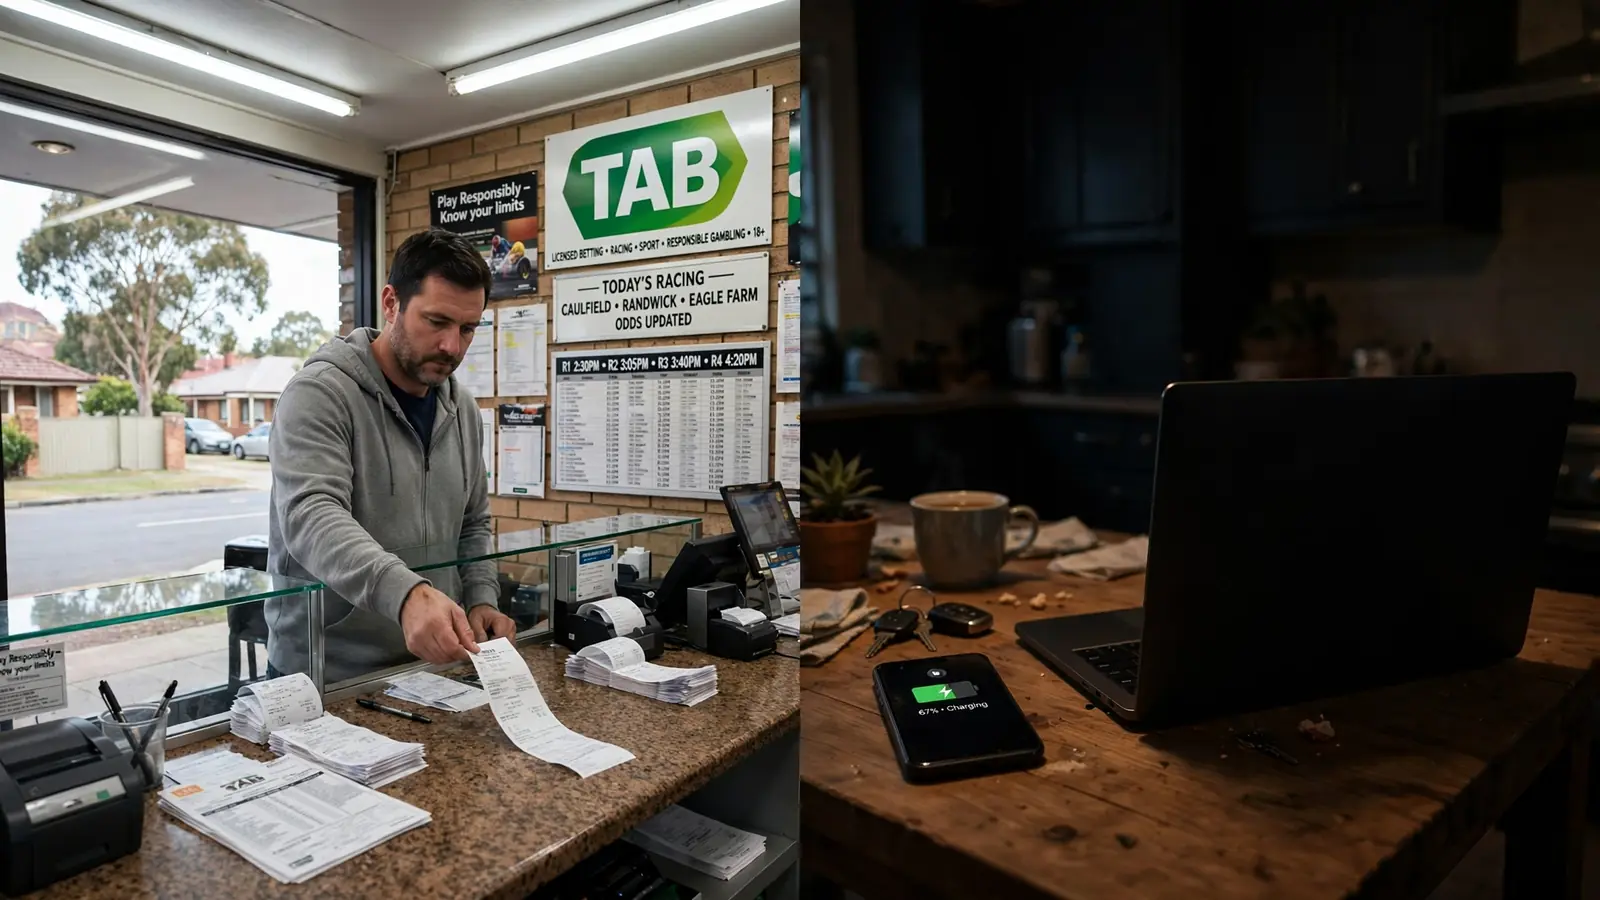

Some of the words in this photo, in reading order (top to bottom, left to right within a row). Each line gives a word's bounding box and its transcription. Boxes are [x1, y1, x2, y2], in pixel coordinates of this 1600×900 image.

[580, 136, 720, 221] TAB
[437, 194, 458, 209] Play
[460, 181, 522, 206] Responsibly
[440, 209, 468, 224] Know
[470, 205, 493, 222] your
[495, 199, 525, 215] limits
[552, 249, 578, 262] LICENSED
[579, 246, 603, 259] BETTING
[610, 242, 633, 254] RACING
[639, 239, 660, 251] SPORT
[667, 232, 709, 248] RESPONSIBLE
[710, 228, 746, 242] GAMBLING
[753, 227, 765, 238] 18+
[602, 275, 652, 295] TODAY'S
[656, 270, 705, 289] RACING
[561, 300, 611, 316] CAULFIELD
[622, 294, 677, 312] RANDWICK
[689, 291, 723, 307] EAGLE
[727, 287, 758, 303] FARM
[615, 316, 643, 331] ODDS
[645, 312, 692, 329] UPDATED
[562, 361, 571, 372] R1
[573, 359, 600, 372] 2:30PM
[608, 359, 618, 371] R2
[620, 357, 649, 371] 3:05PM
[657, 357, 668, 369] R3
[670, 355, 701, 369] 3:40PM
[710, 354, 723, 367] R4
[724, 352, 758, 366] 4:20PM
[918, 707, 939, 716] 67%
[946, 701, 989, 712] Charging
